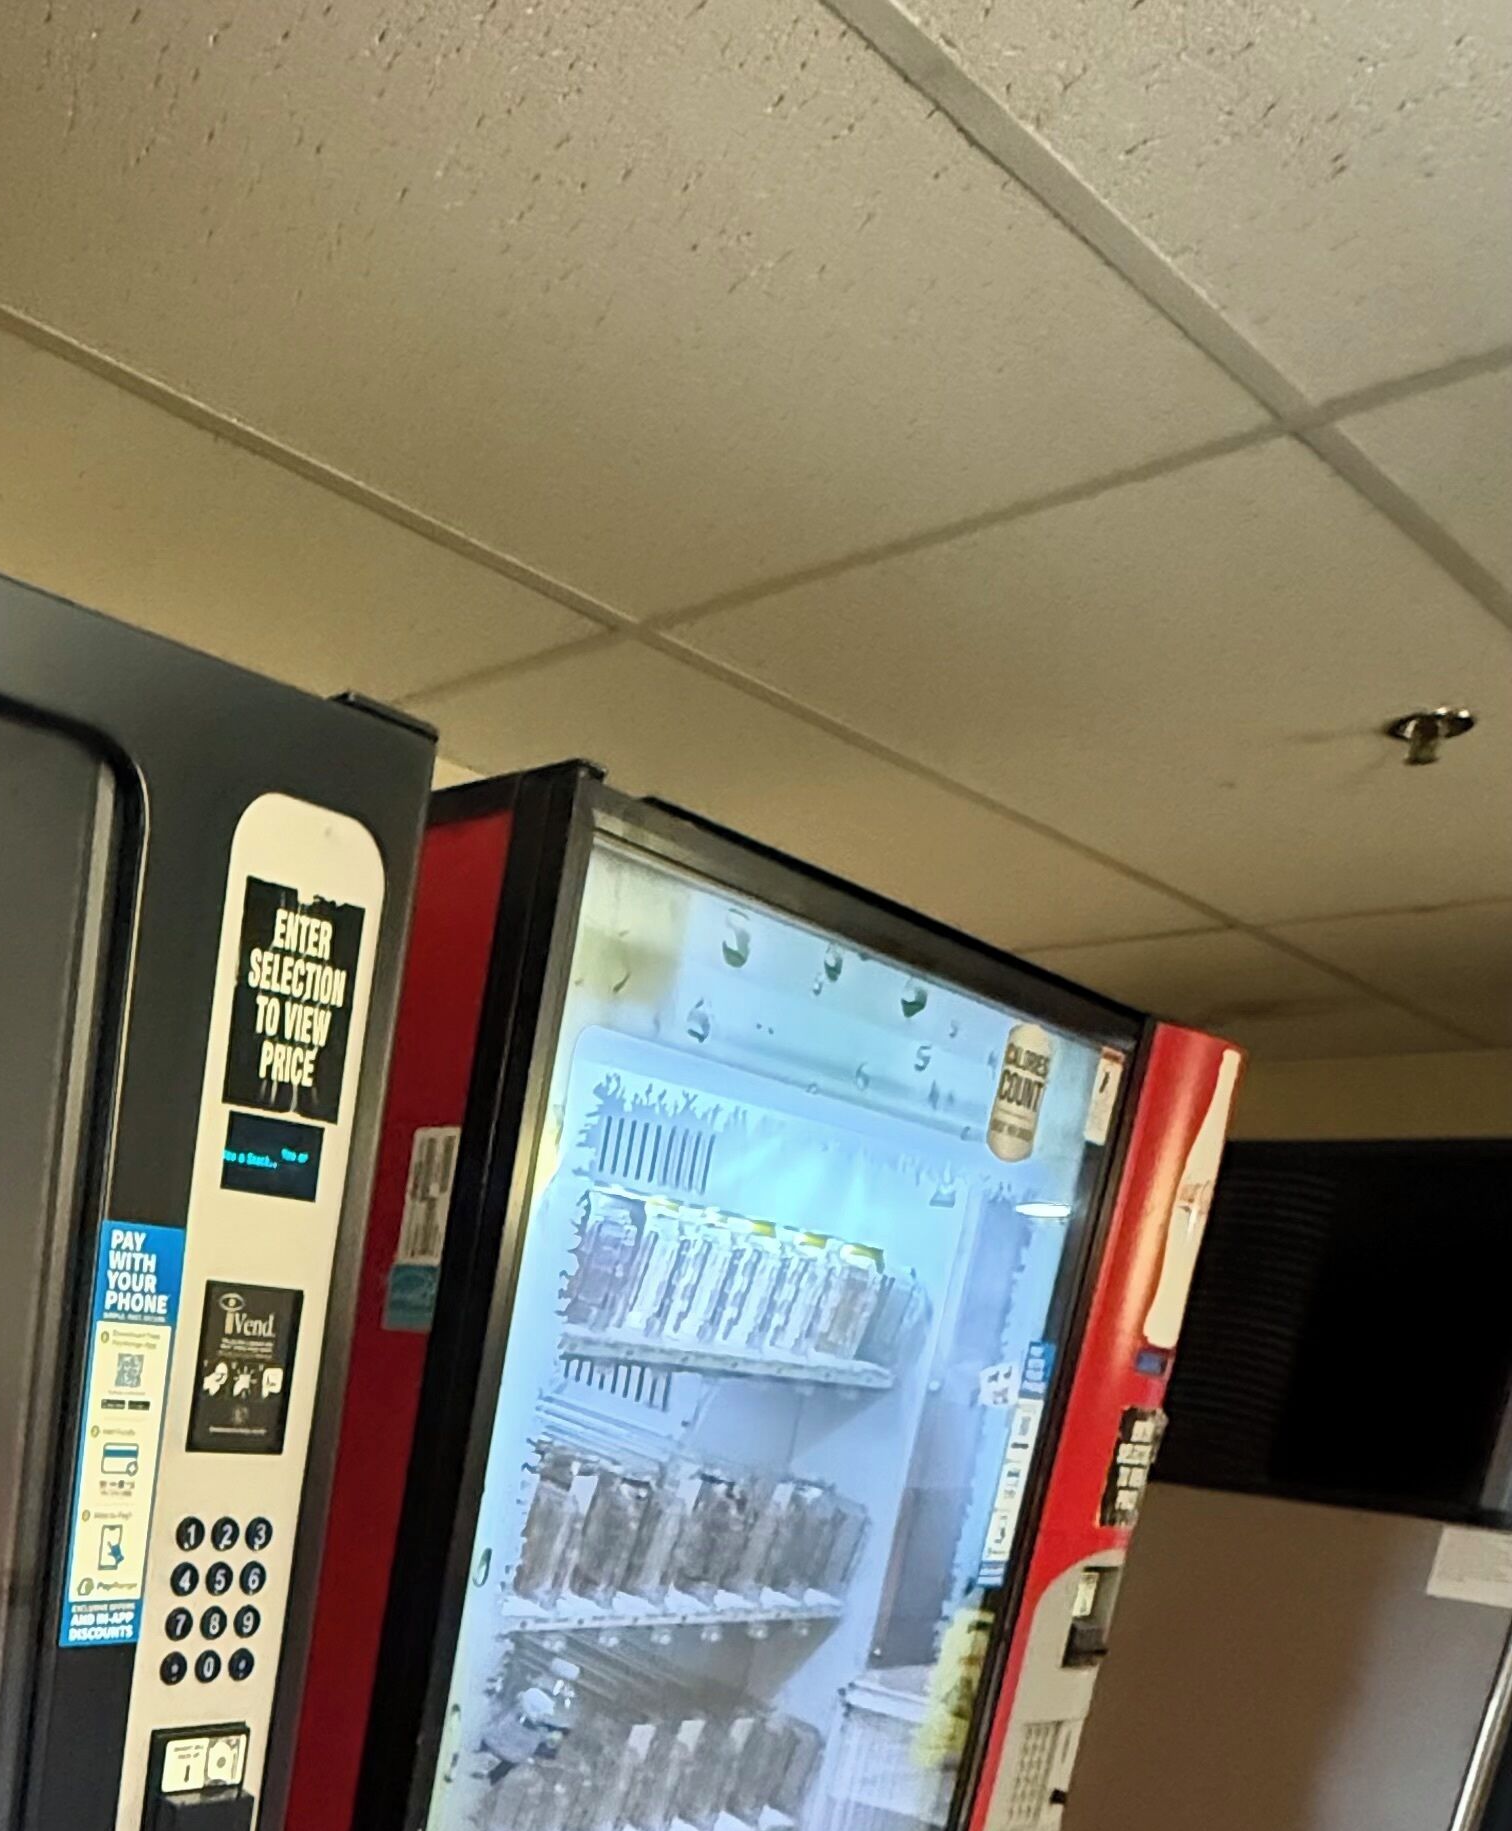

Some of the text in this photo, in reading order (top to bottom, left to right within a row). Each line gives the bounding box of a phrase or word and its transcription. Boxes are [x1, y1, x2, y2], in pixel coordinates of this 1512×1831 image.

[273, 909, 333, 960] ENTER
[248, 948, 346, 1008] SELECTION
[255, 995, 331, 1047] TO VIEW
[258, 1042, 316, 1088] PRICE
[998, 1069, 1045, 1113] COUNT
[110, 1228, 147, 1252] PAY
[108, 1250, 157, 1274] WITH
[106, 1270, 158, 1294] YOUR
[103, 1290, 169, 1315] PHONE
[220, 1523, 233, 1546] 2
[255, 1523, 267, 1546] 3
[179, 1567, 261, 1591] 4 5 6
[70, 1613, 95, 1627] AND
[175, 1611, 254, 1636] 7 8 9
[69, 1624, 134, 1642] DISCOUNTS
[203, 1657, 215, 1679] 0
